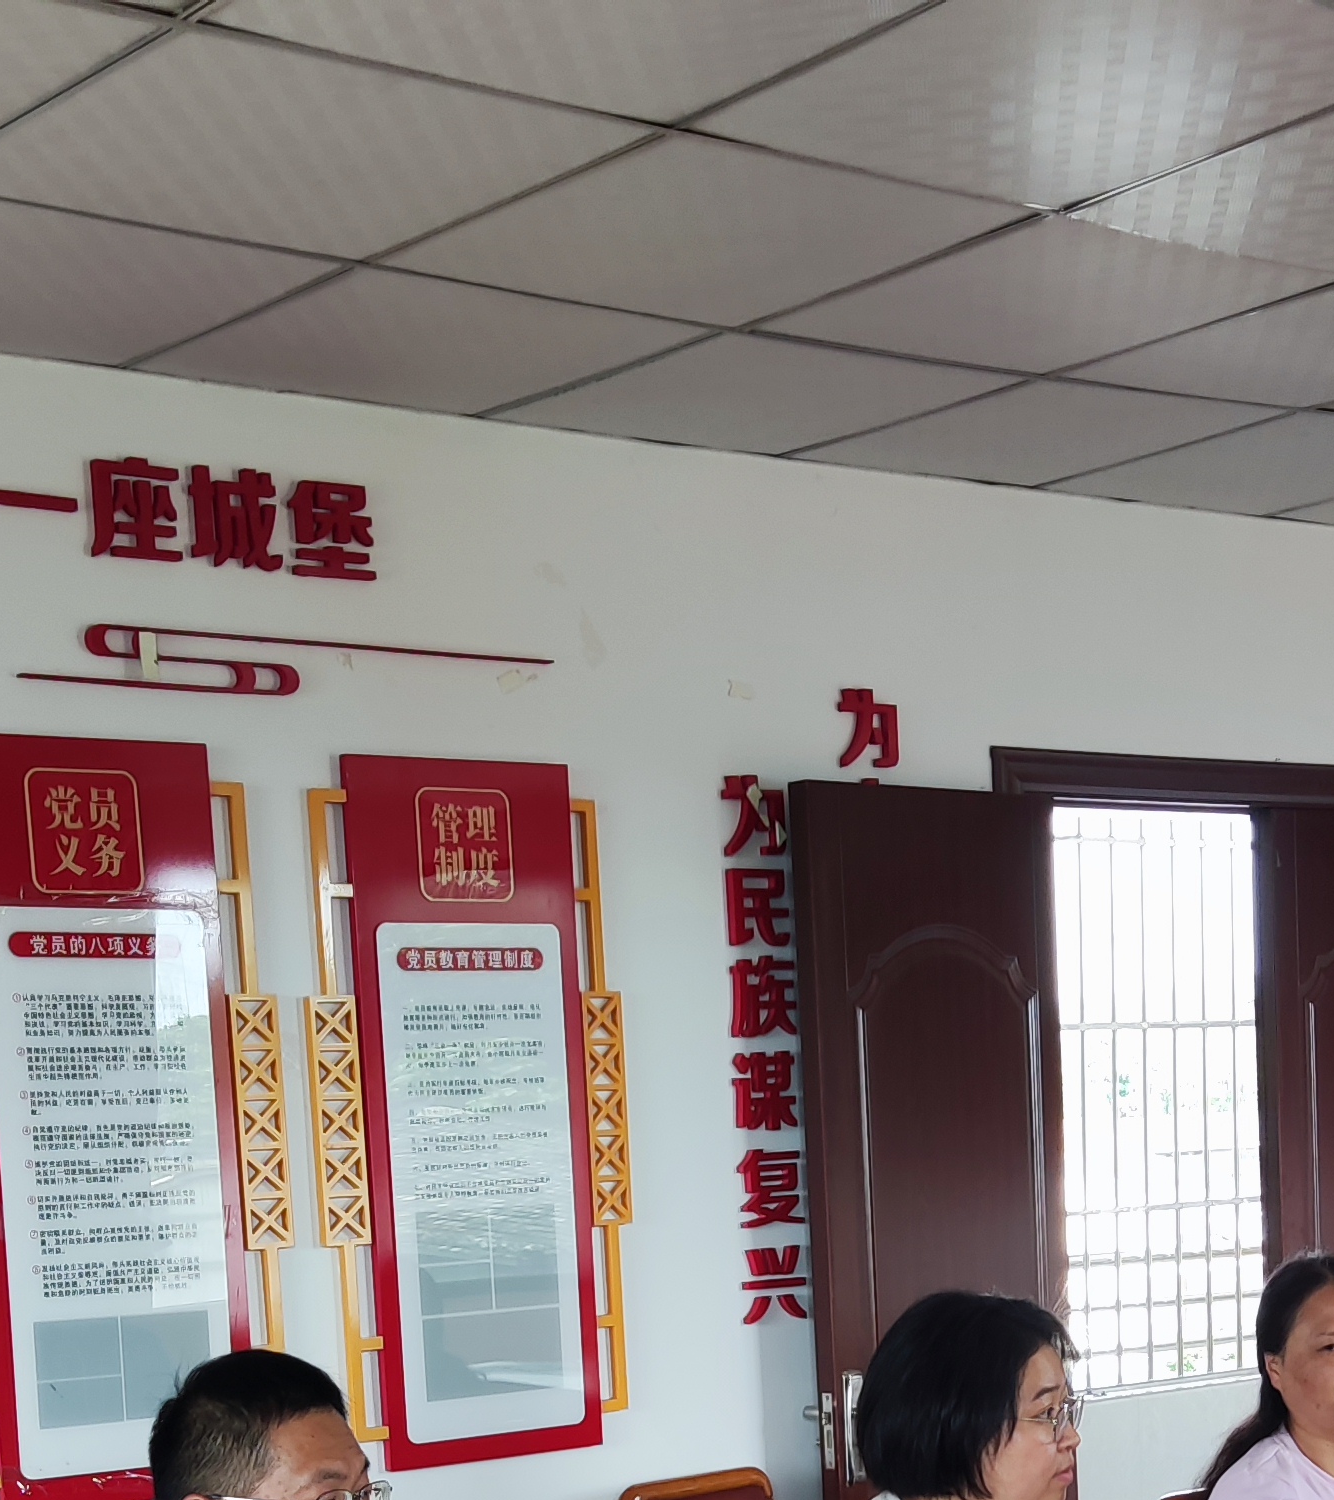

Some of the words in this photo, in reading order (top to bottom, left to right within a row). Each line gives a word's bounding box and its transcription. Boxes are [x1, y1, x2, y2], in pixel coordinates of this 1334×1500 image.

[837, 687, 900, 785] 为
[45, 785, 121, 831] 党员
[431, 802, 498, 844] 管理
[49, 834, 126, 877] 义务
[433, 846, 501, 889] 制度
[405, 948, 536, 970] 党员教育管理制度
[720, 773, 808, 1325] 为民族谋复兴
